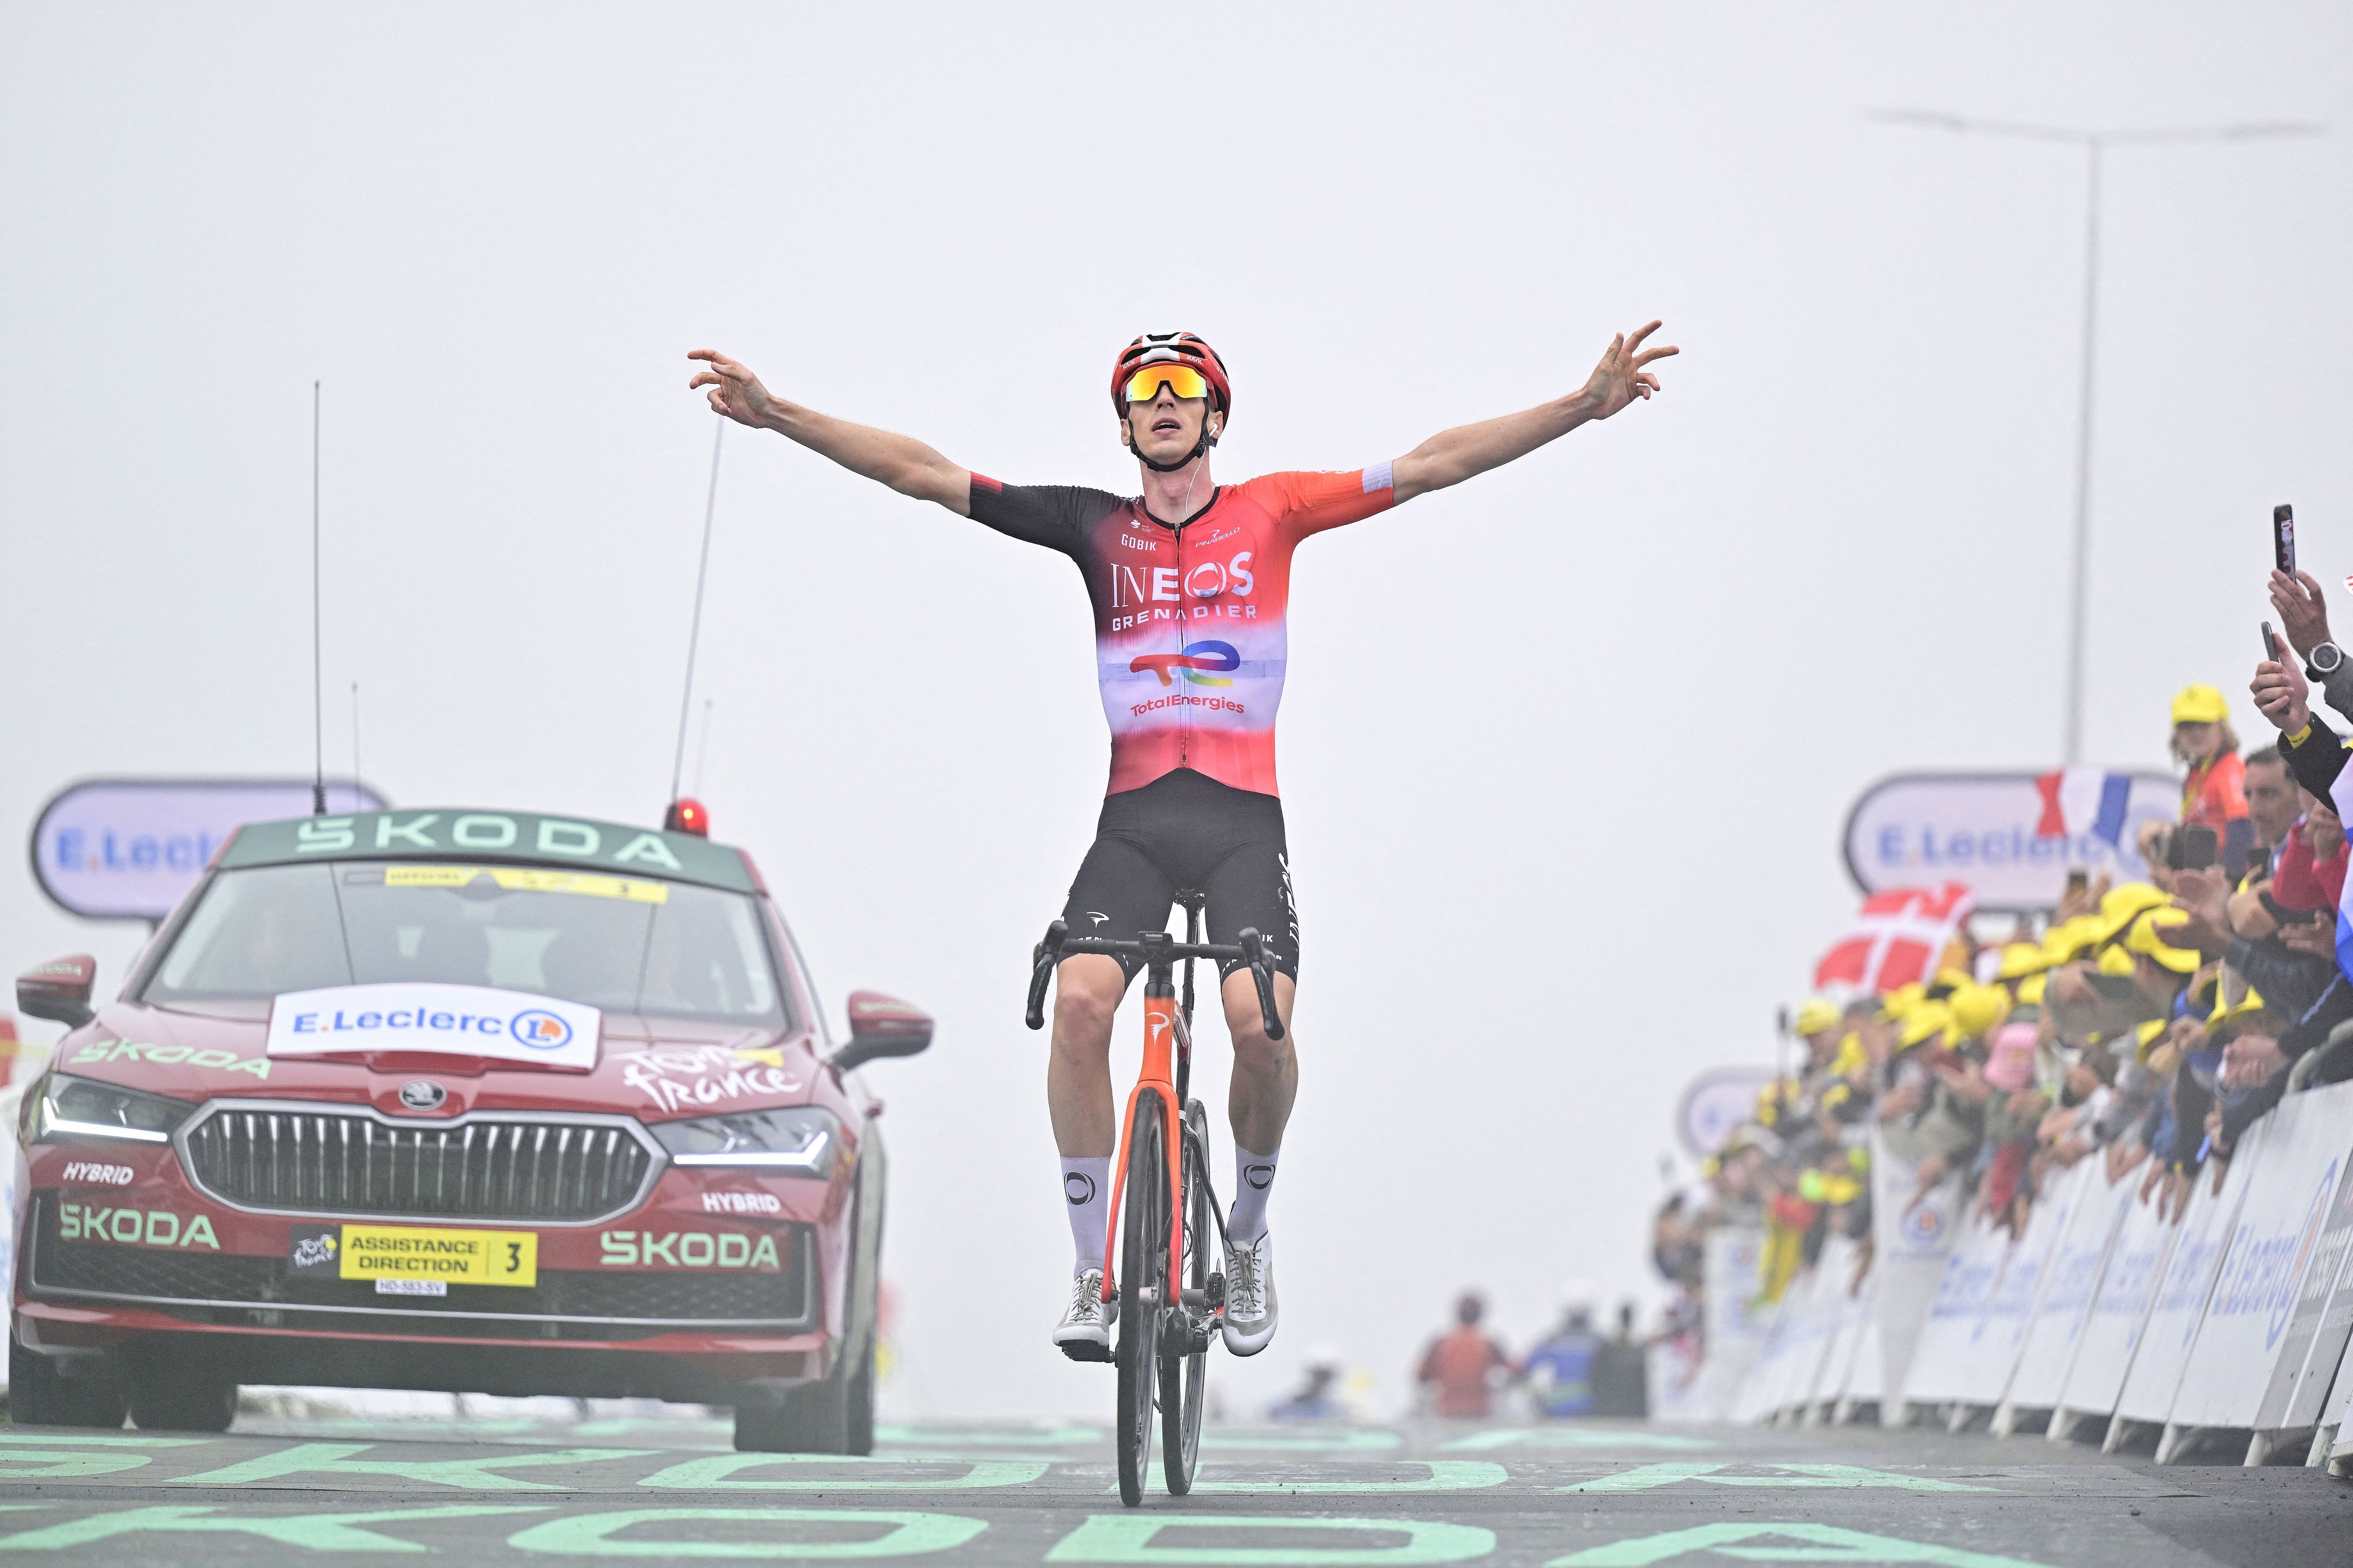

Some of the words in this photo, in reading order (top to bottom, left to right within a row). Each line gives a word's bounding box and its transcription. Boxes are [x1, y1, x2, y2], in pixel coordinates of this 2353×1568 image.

[1187, 355, 1203, 364] KASK
[1121, 533, 1157, 551] GOBIK
[1196, 527, 1240, 548] PINARELLO
[1111, 551, 1254, 608] INEOS
[1112, 605, 1257, 632] GRENADIER
[1130, 694, 1245, 717] TotalEnergies
[292, 1007, 503, 1035] E.Leclerc
[62, 1161, 134, 1186] HYBRID
[702, 1192, 781, 1213] HYBRID
[350, 1236, 479, 1255] ASSISTANCE
[358, 1255, 469, 1273] DIRECTION
[505, 1242, 521, 1272] 3
